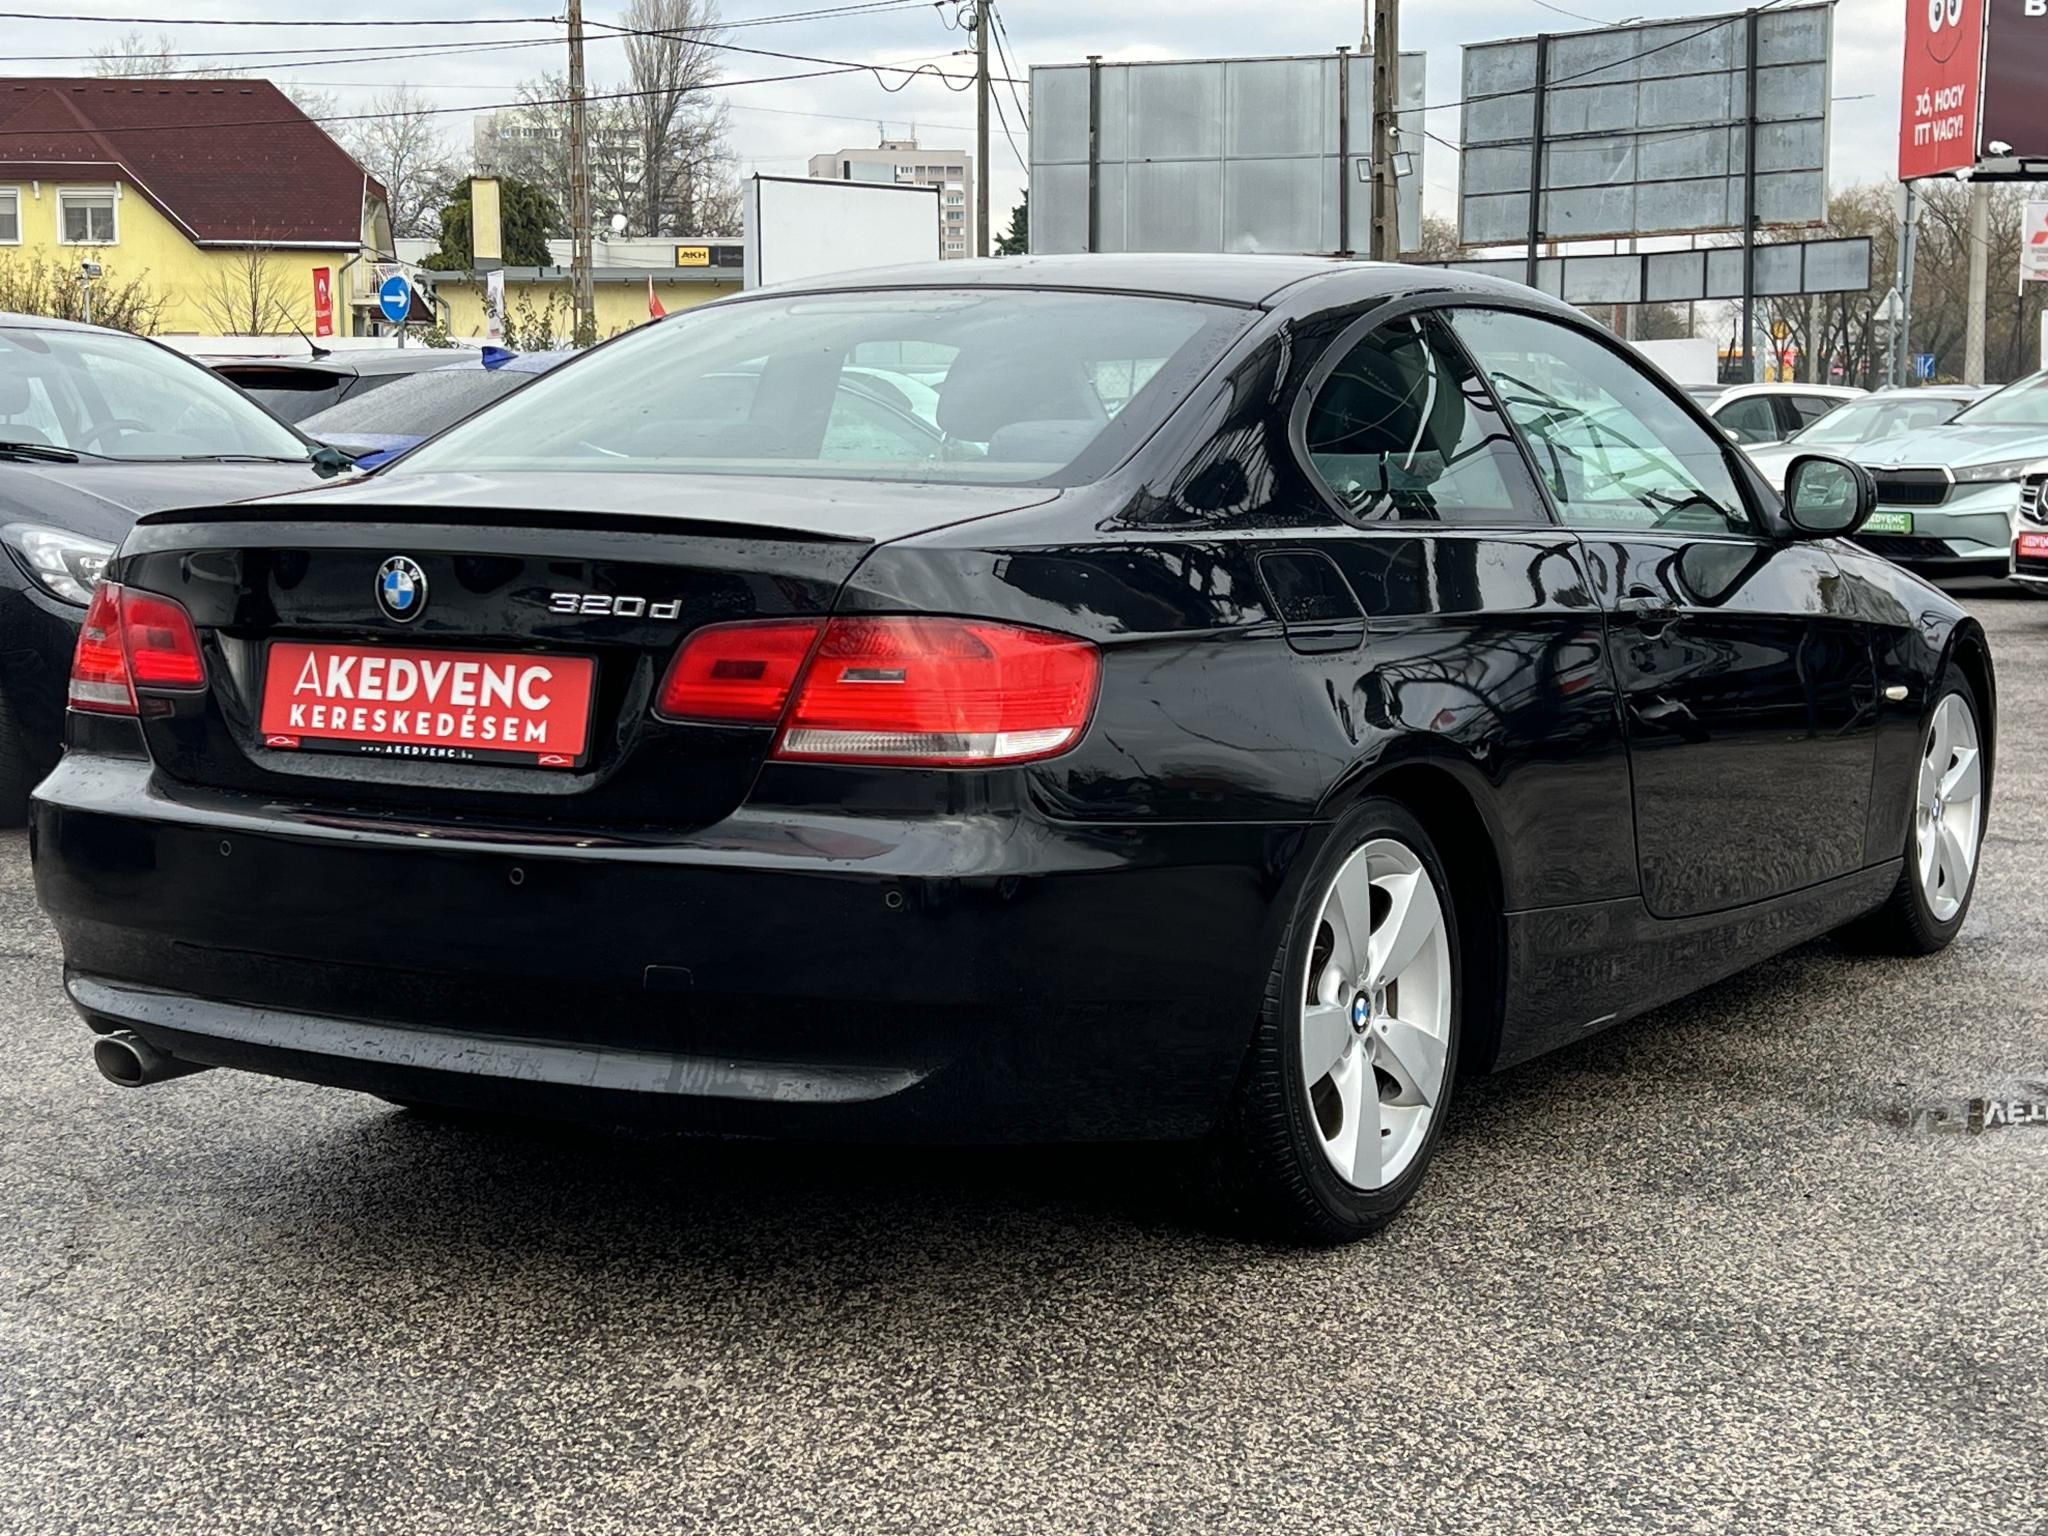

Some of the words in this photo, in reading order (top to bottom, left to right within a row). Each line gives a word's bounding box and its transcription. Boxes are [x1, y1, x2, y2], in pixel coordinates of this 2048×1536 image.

[1914, 87, 1932, 117] JÓ,
[1935, 84, 1965, 113] HOGY
[1914, 122, 1931, 146] ITT
[1933, 115, 1963, 143] VAGY!
[380, 559, 421, 581] BMW
[293, 651, 553, 711] AKEDVENC
[289, 703, 548, 744] KERESKEDÉSEM
